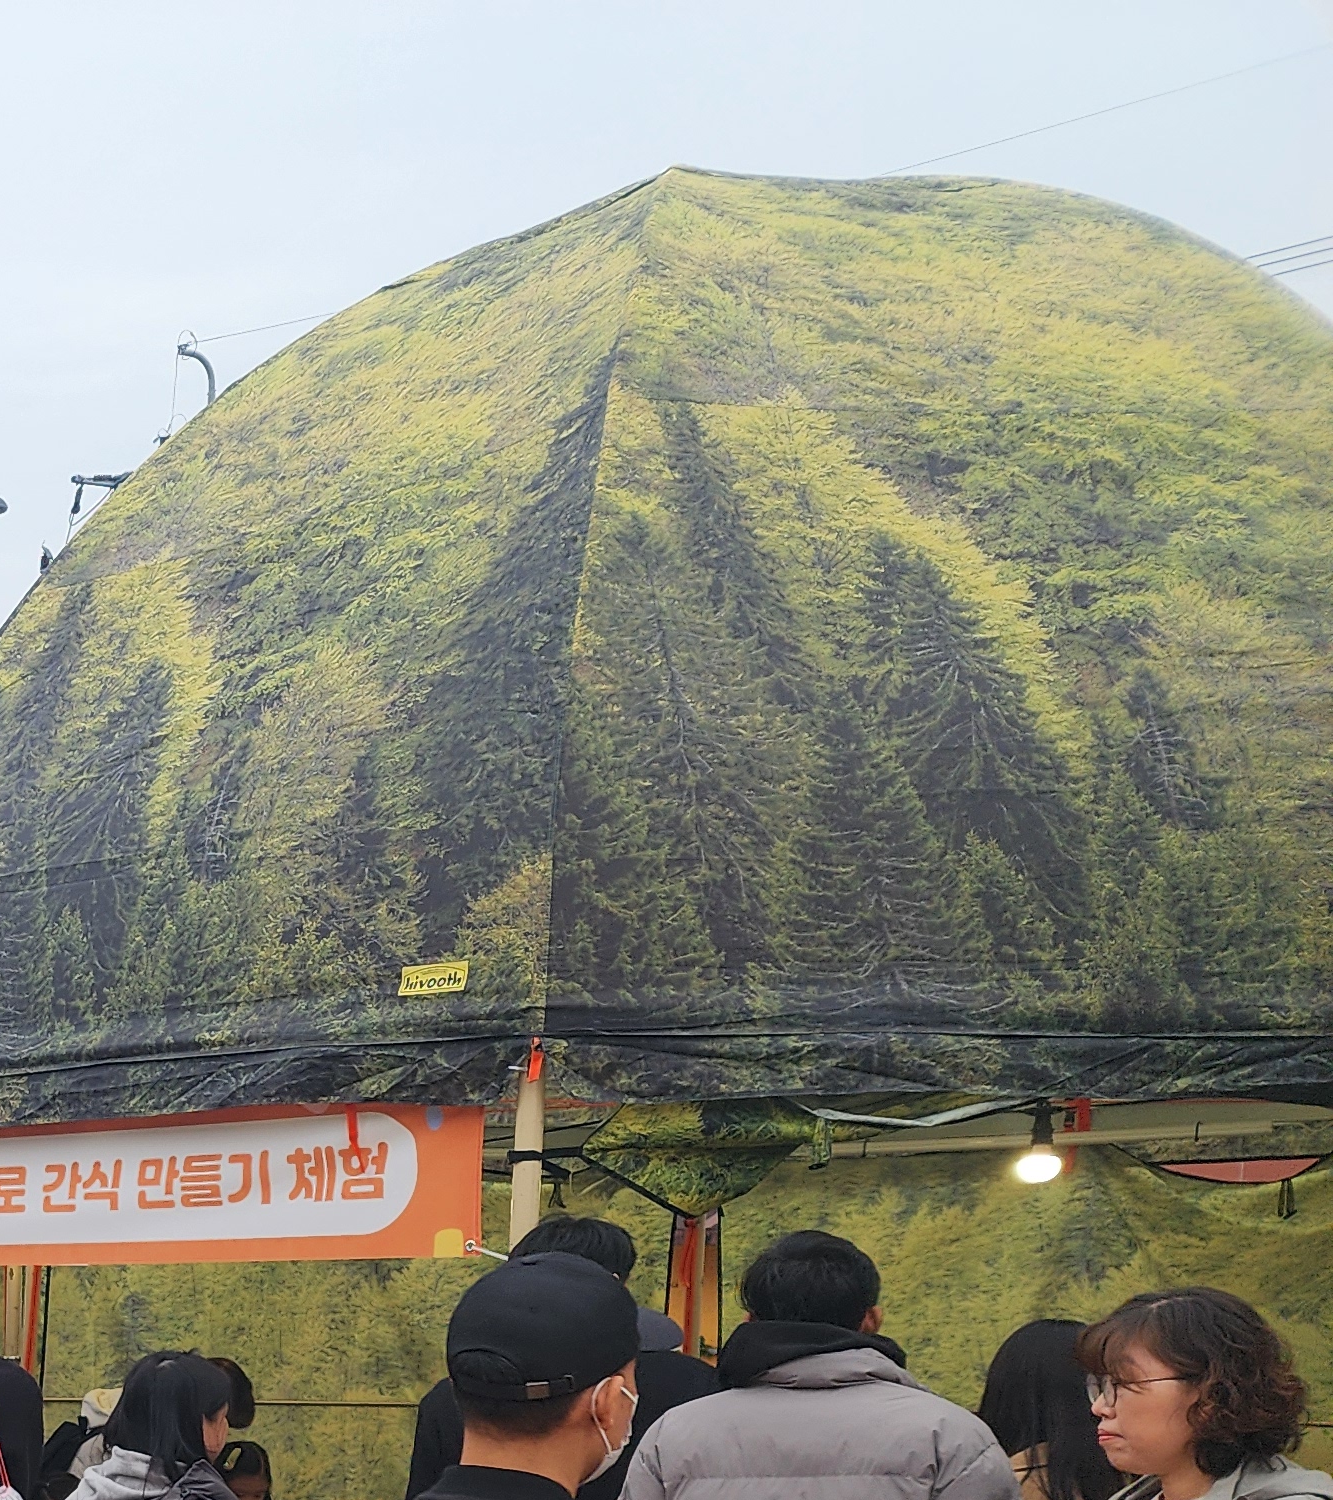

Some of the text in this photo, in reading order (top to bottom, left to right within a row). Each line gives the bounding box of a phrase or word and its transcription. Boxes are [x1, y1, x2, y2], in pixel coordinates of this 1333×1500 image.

[42, 1159, 123, 1213] 간식
[137, 1149, 271, 1210] 만들기
[288, 1142, 389, 1203] 체험
